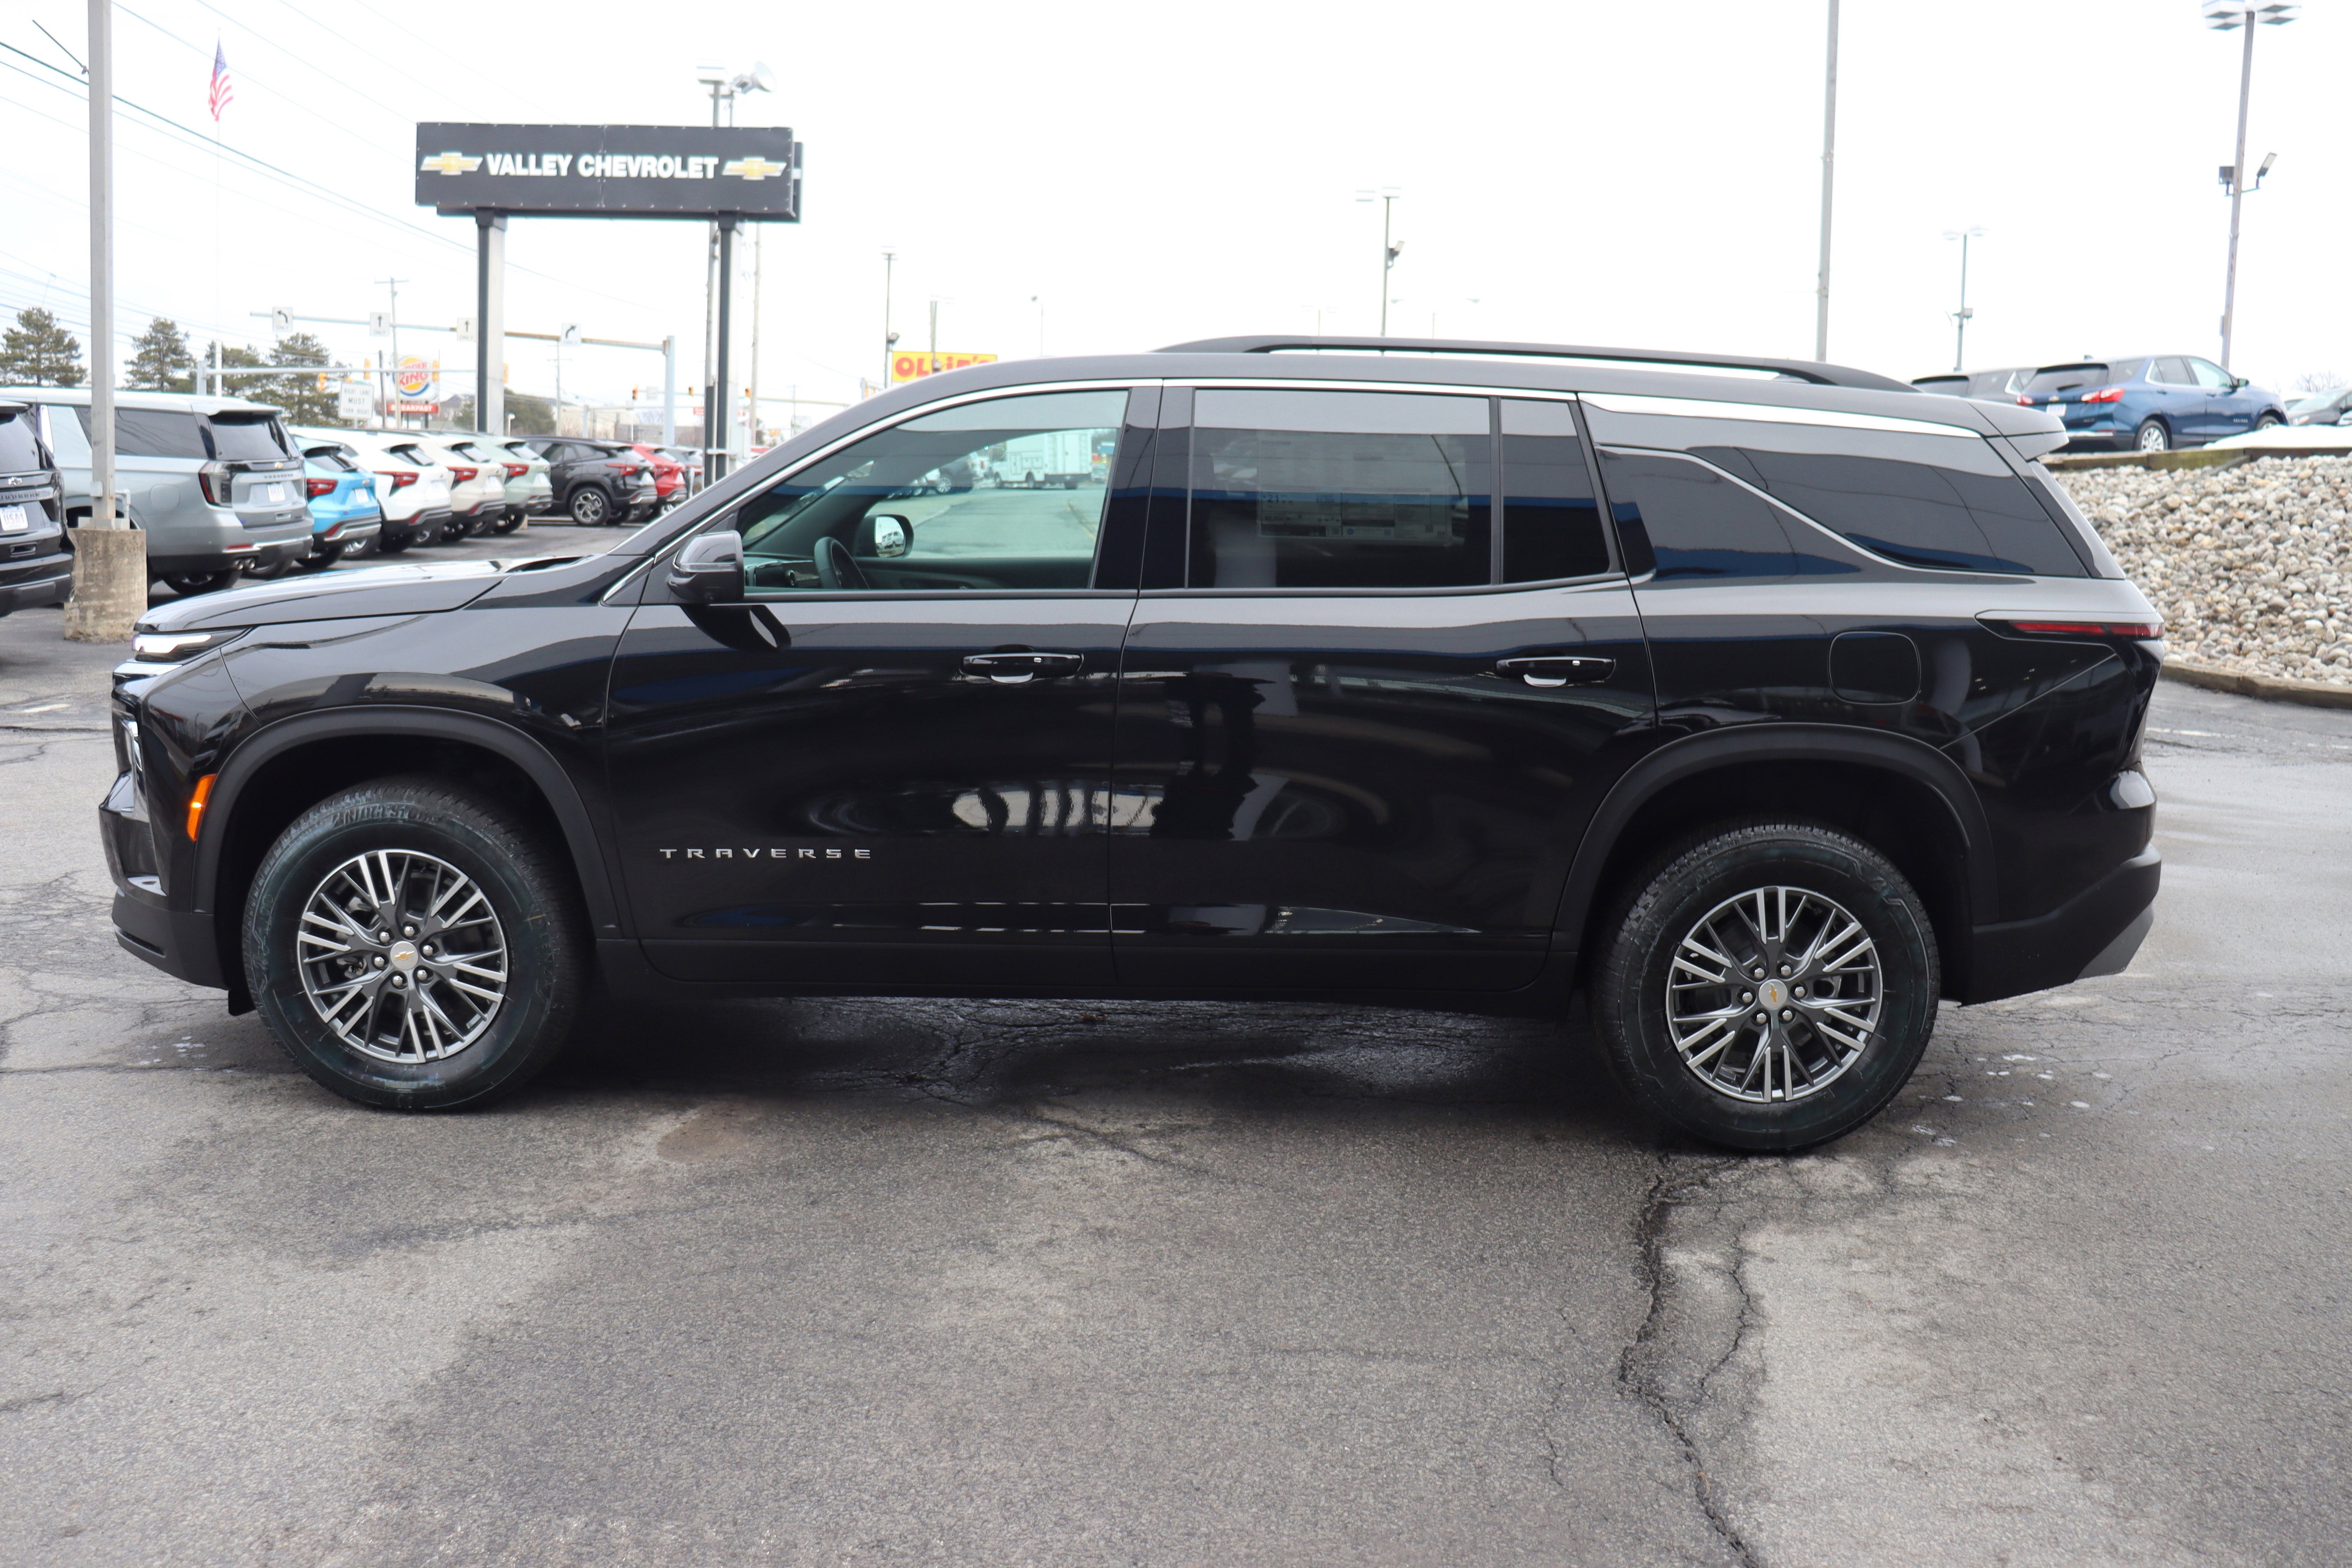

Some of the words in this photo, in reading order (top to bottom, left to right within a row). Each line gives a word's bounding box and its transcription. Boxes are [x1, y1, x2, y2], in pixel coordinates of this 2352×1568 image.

[487, 154, 572, 176] VALLEY
[578, 155, 719, 179] CHEVROLET
[399, 371, 429, 386] KING
[391, 404, 432, 412] BEAKFAST
[3, 513, 24, 524] USA1
[659, 848, 871, 859] TRAVERSE
